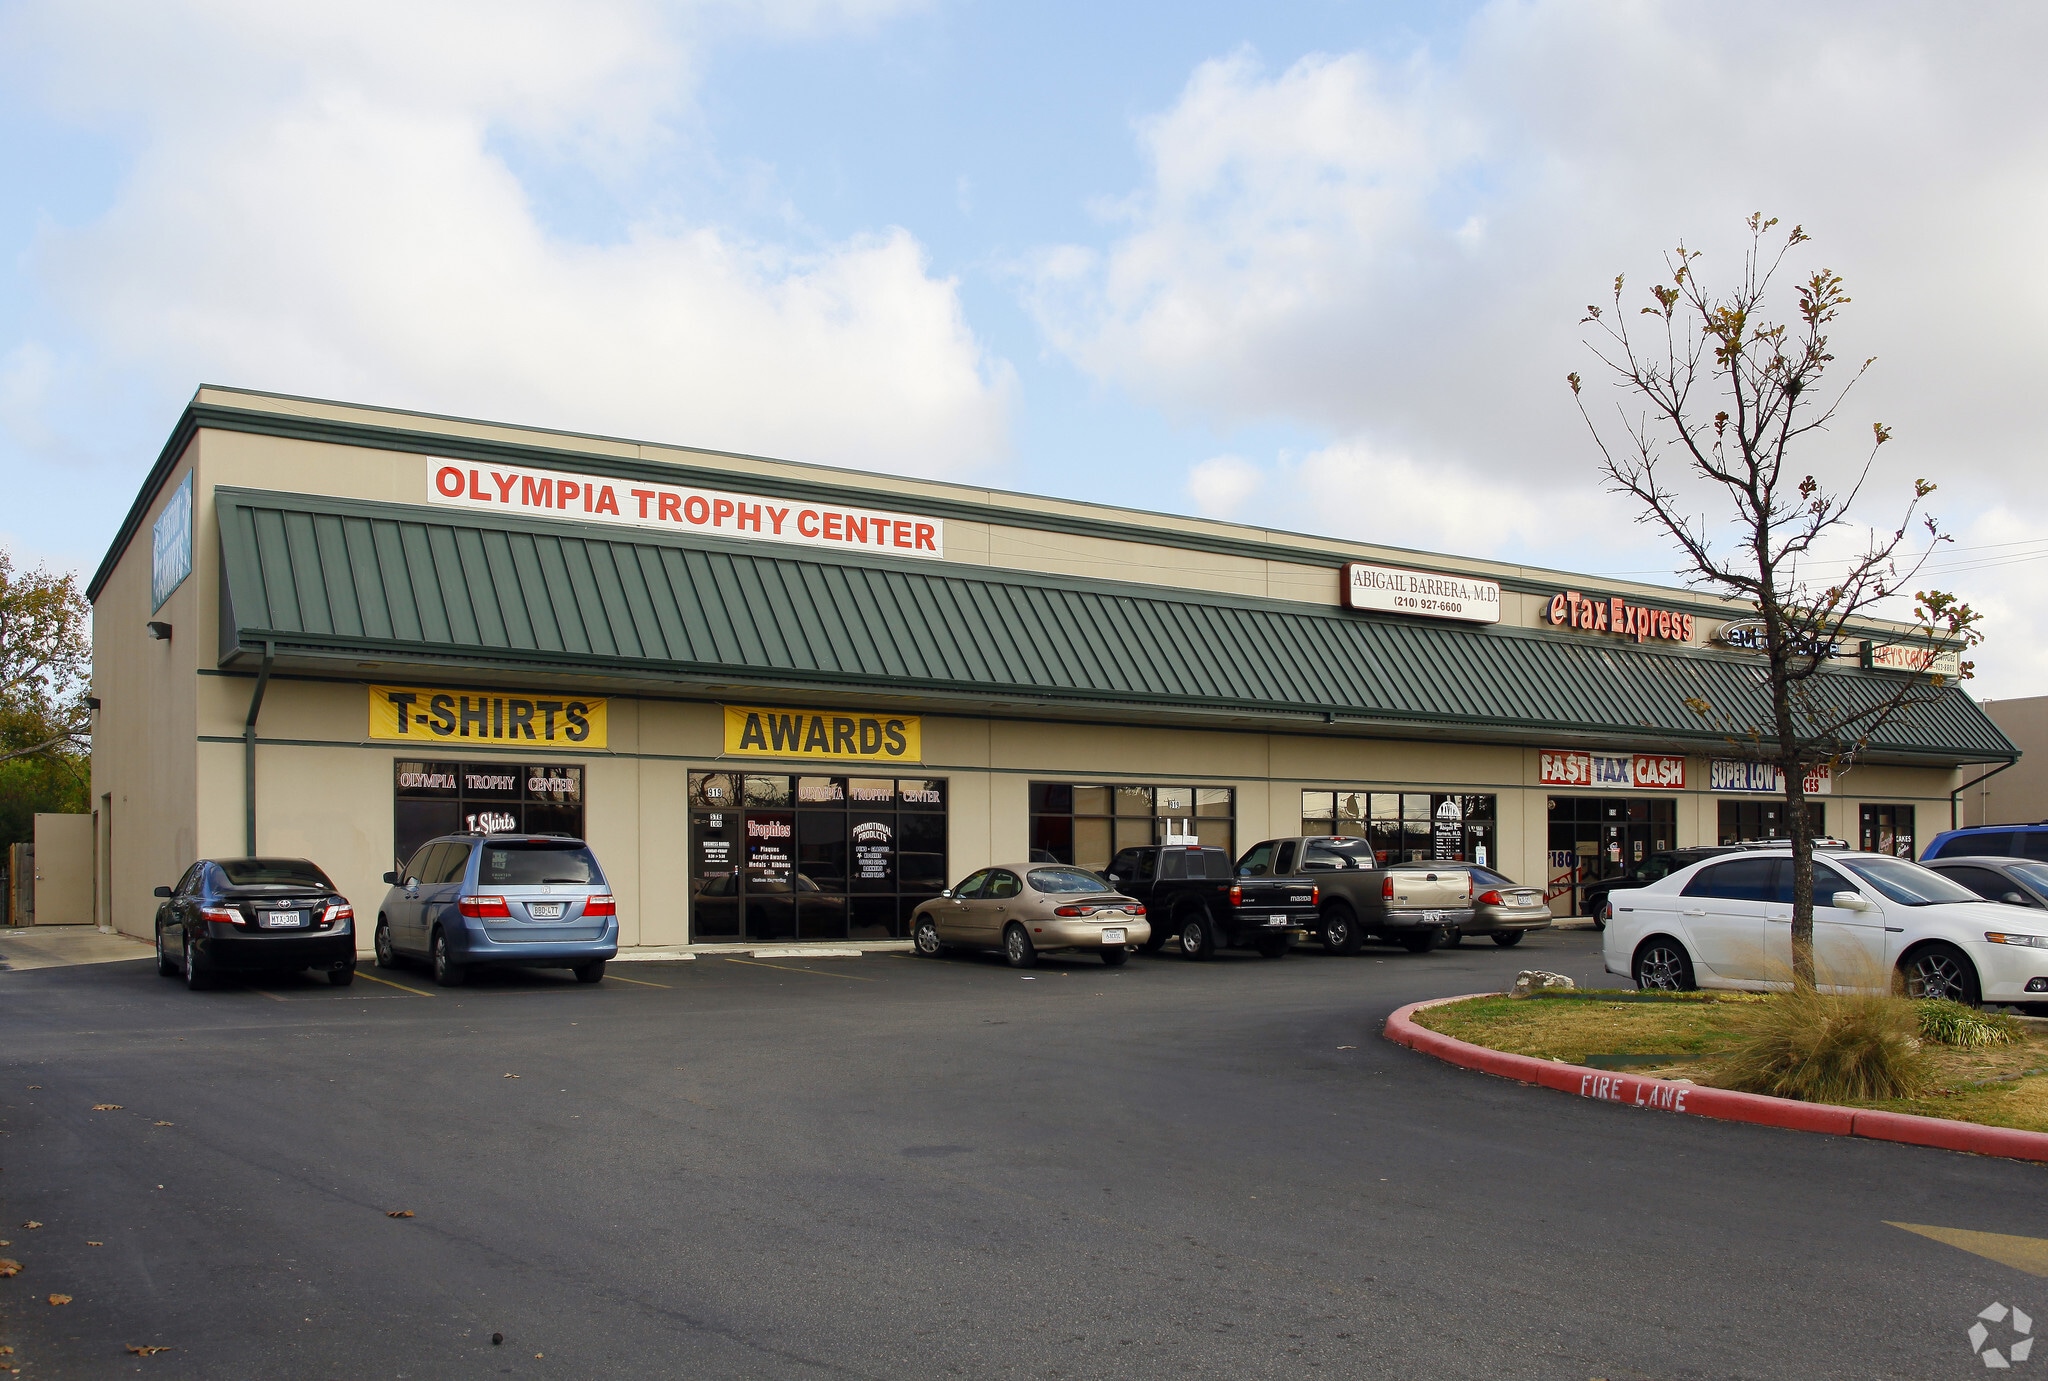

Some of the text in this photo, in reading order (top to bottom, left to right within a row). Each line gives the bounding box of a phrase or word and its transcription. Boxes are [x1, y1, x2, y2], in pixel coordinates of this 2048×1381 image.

[435, 466, 937, 551] OLYMPIA TROPHY CENTER
[1353, 570, 1498, 603] ABIGAIL BARRERA, M.D.
[1394, 596, 1462, 613] (210) 927-6600
[1547, 591, 1695, 643] eTax Express
[388, 692, 590, 742] T-SHIRTS
[739, 712, 907, 756] AWARDS
[1594, 757, 1629, 783] TAX
[1711, 760, 1775, 789] SUPER LOW
[400, 773, 575, 793] OLYMPIA TROPHY CENTER
[708, 788, 722, 797] 919
[799, 786, 941, 803] OLYMPIA TROPHY CENTER
[466, 812, 516, 834] T-Shirts
[747, 820, 791, 840] Trophies
[852, 822, 893, 838] PROMOTIONAL
[858, 831, 888, 843] PRODUCTS
[1580, 1074, 1691, 1112] FIRE LANE
